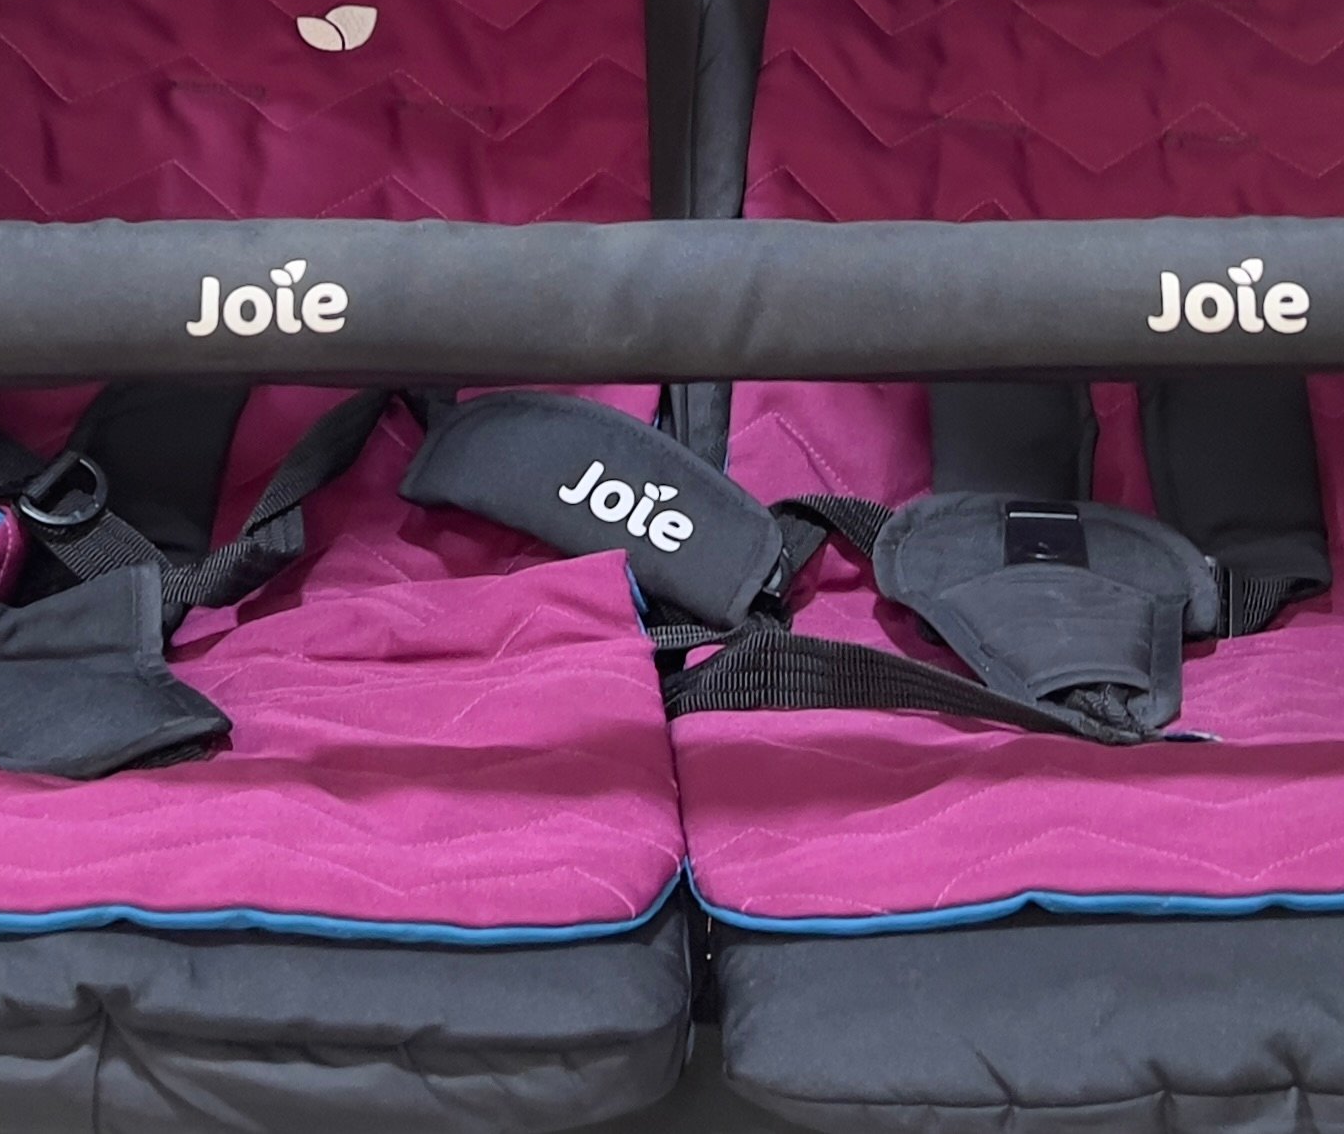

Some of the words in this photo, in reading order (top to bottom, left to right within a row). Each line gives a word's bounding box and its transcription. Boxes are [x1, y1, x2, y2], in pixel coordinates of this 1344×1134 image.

[186, 259, 349, 336] Joie
[1147, 258, 1311, 334] Joie
[558, 460, 695, 553] Joie
